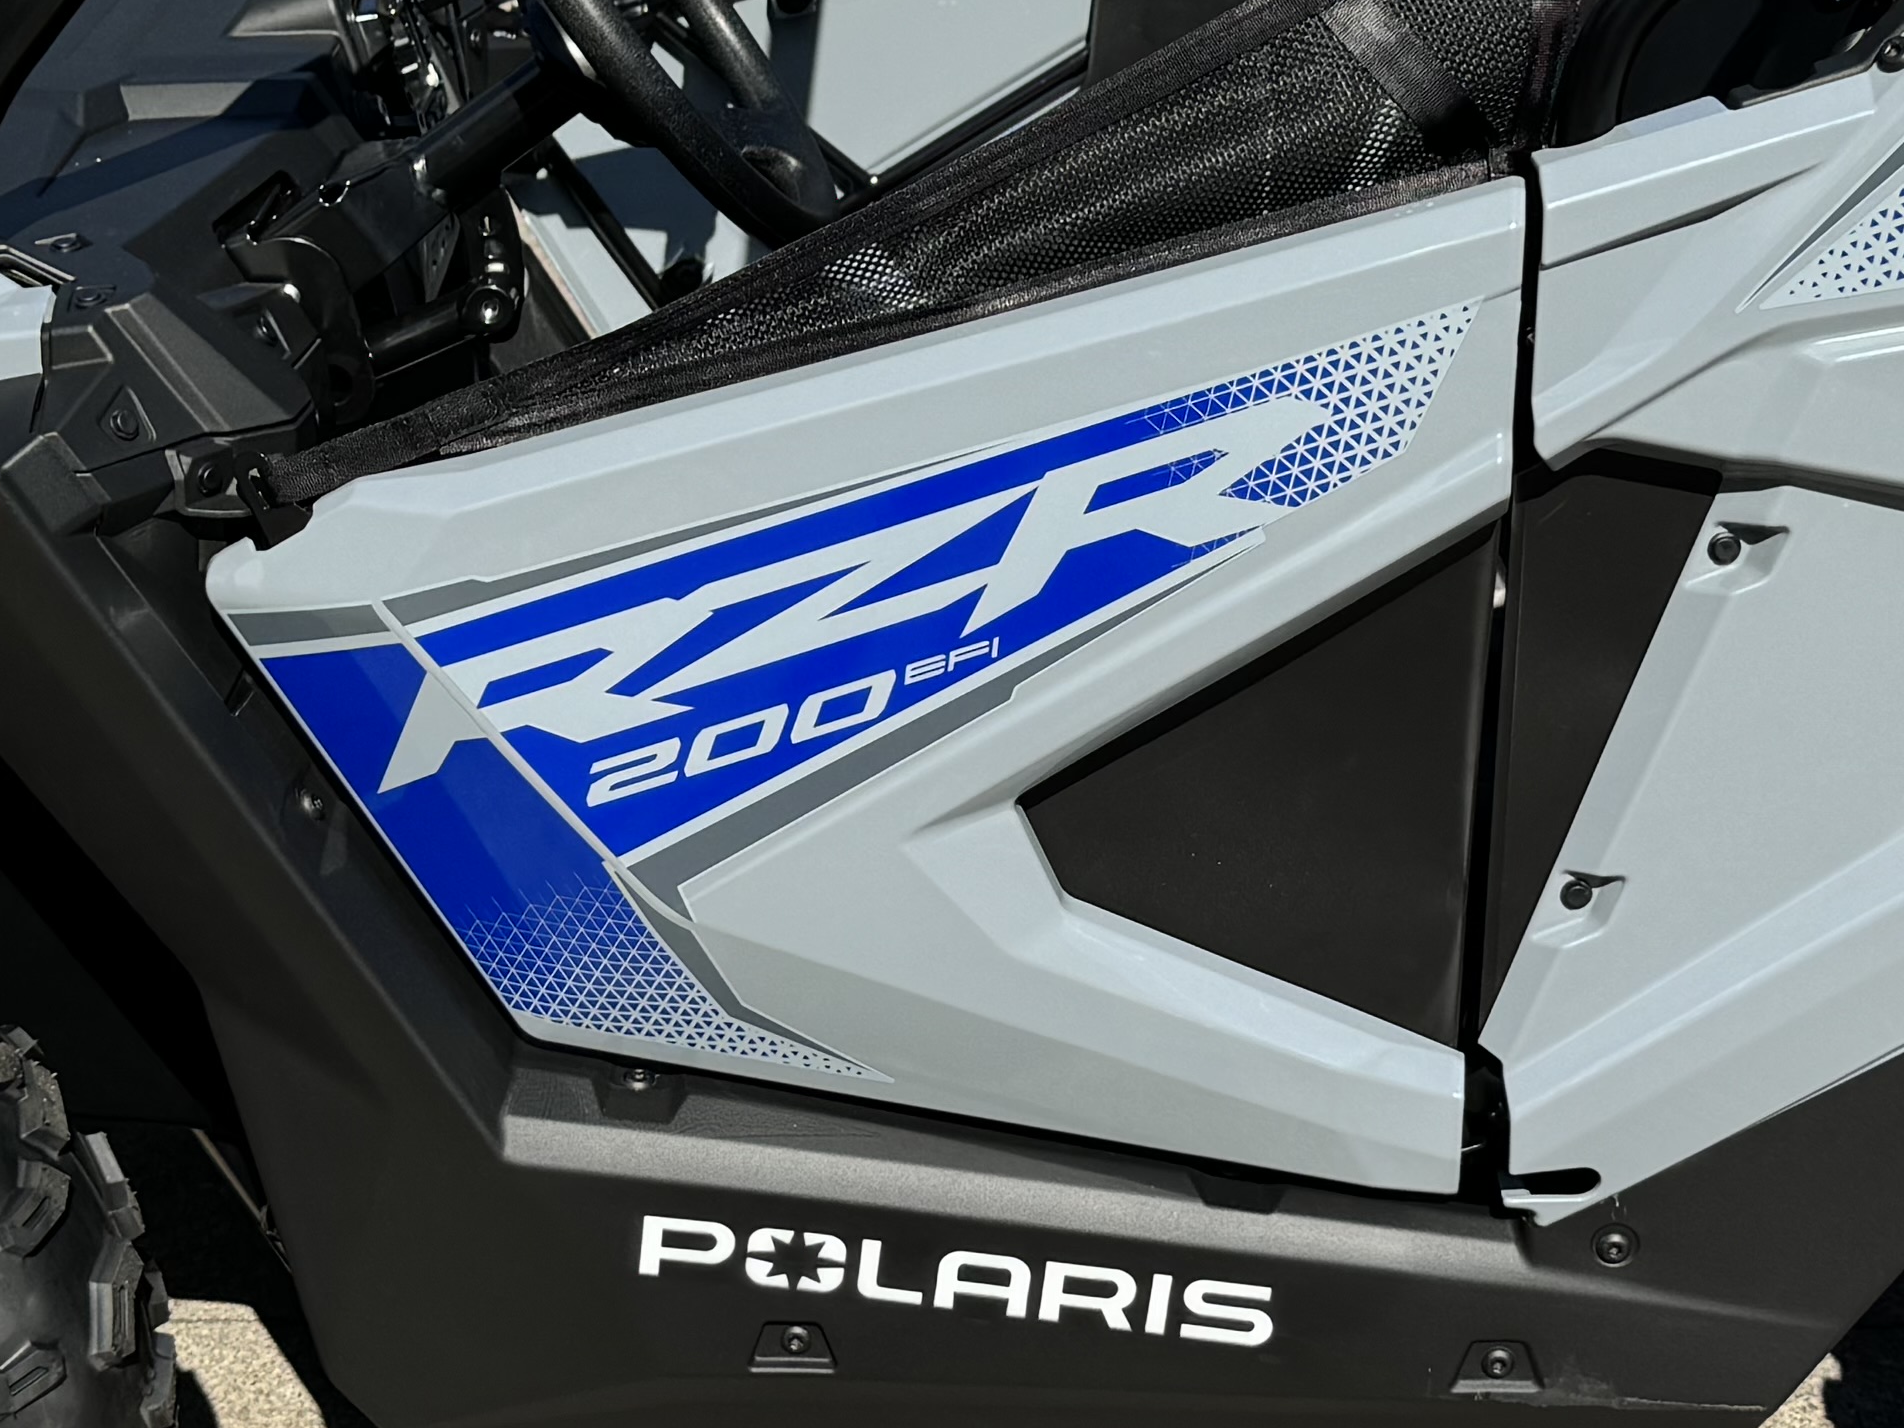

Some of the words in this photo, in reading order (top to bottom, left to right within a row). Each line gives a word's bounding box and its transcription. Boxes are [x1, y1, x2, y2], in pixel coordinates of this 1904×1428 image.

[378, 394, 1332, 794] RZR
[586, 671, 899, 808] 200
[904, 637, 1000, 683] EFI
[639, 1215, 1274, 1346] POLARIS
